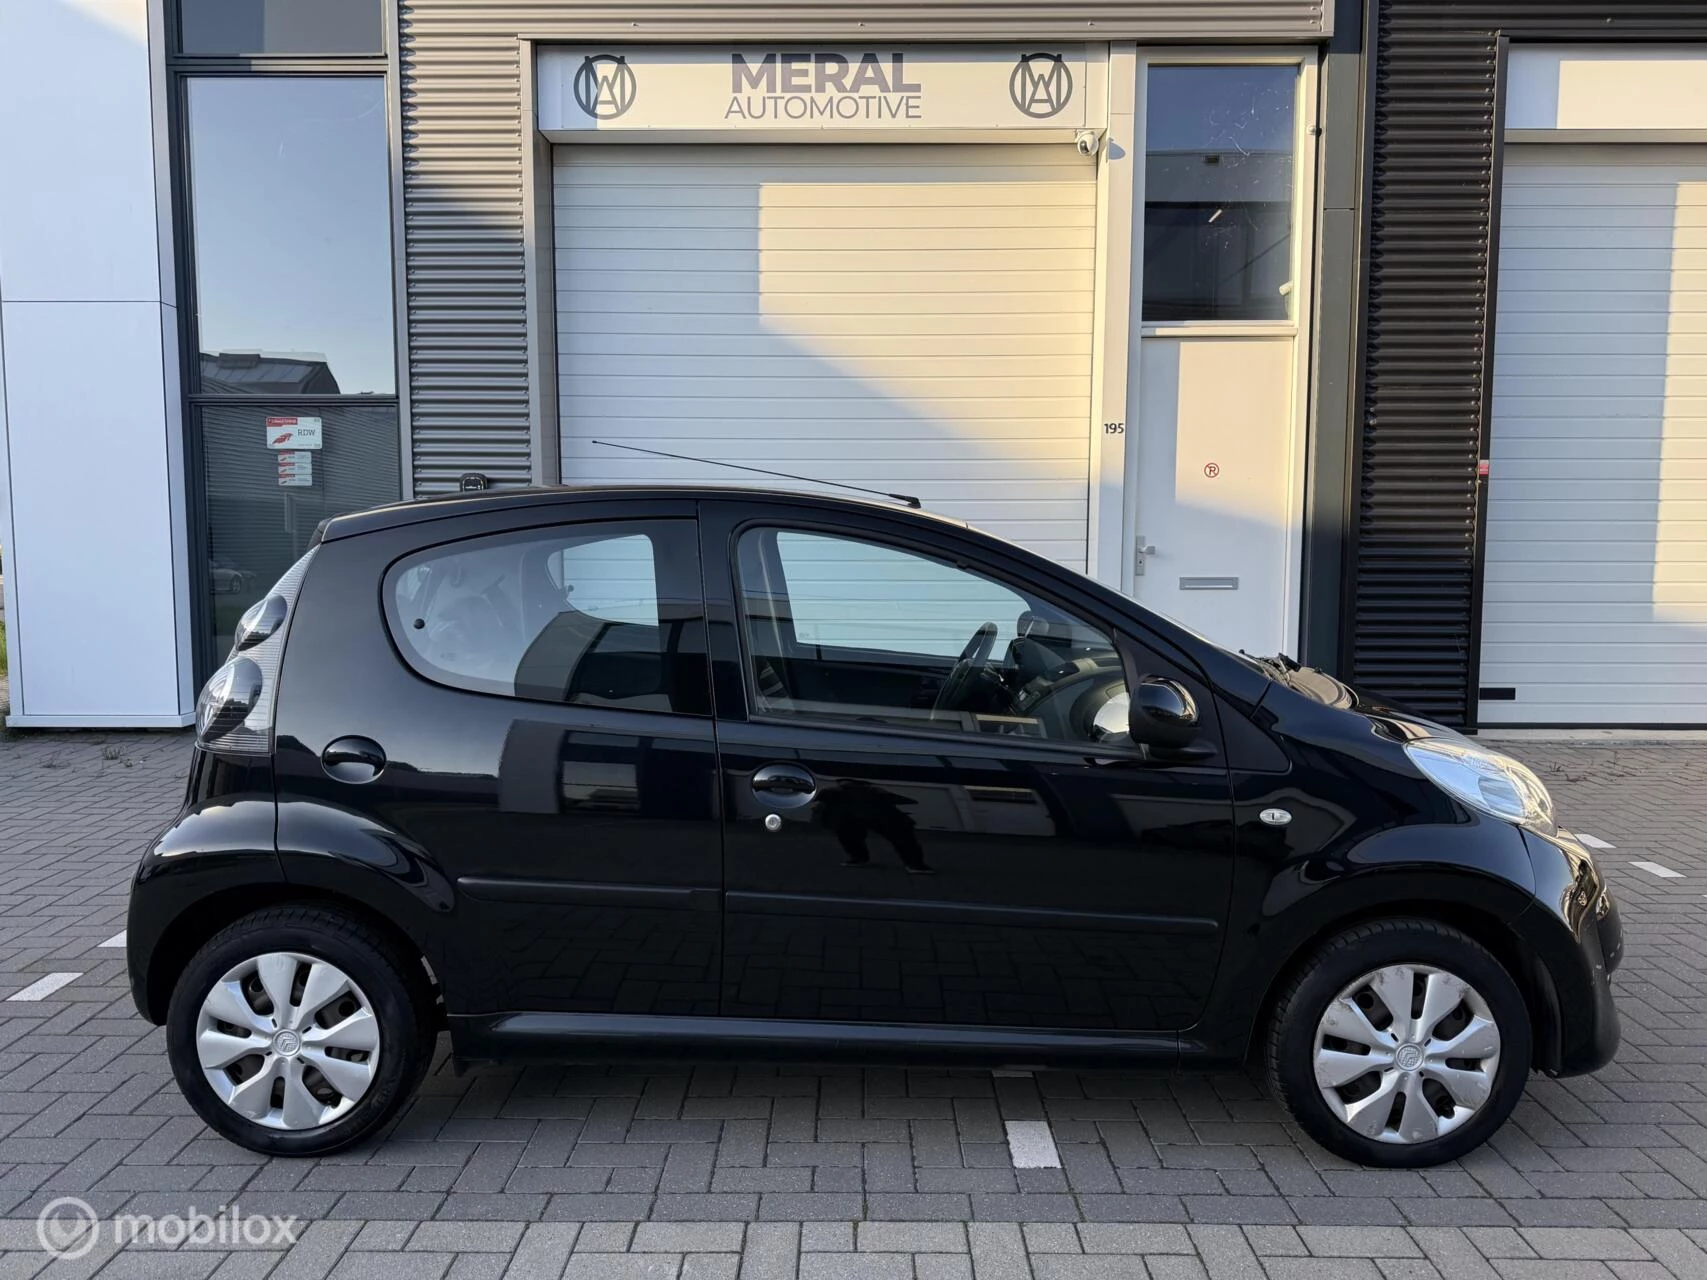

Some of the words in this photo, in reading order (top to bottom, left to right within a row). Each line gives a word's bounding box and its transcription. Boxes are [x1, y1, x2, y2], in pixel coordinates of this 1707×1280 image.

[731, 52, 922, 94] MERAL
[724, 95, 922, 119] AUTOMOTIVE
[297, 428, 316, 437] RDW
[1103, 422, 1125, 434] 195
